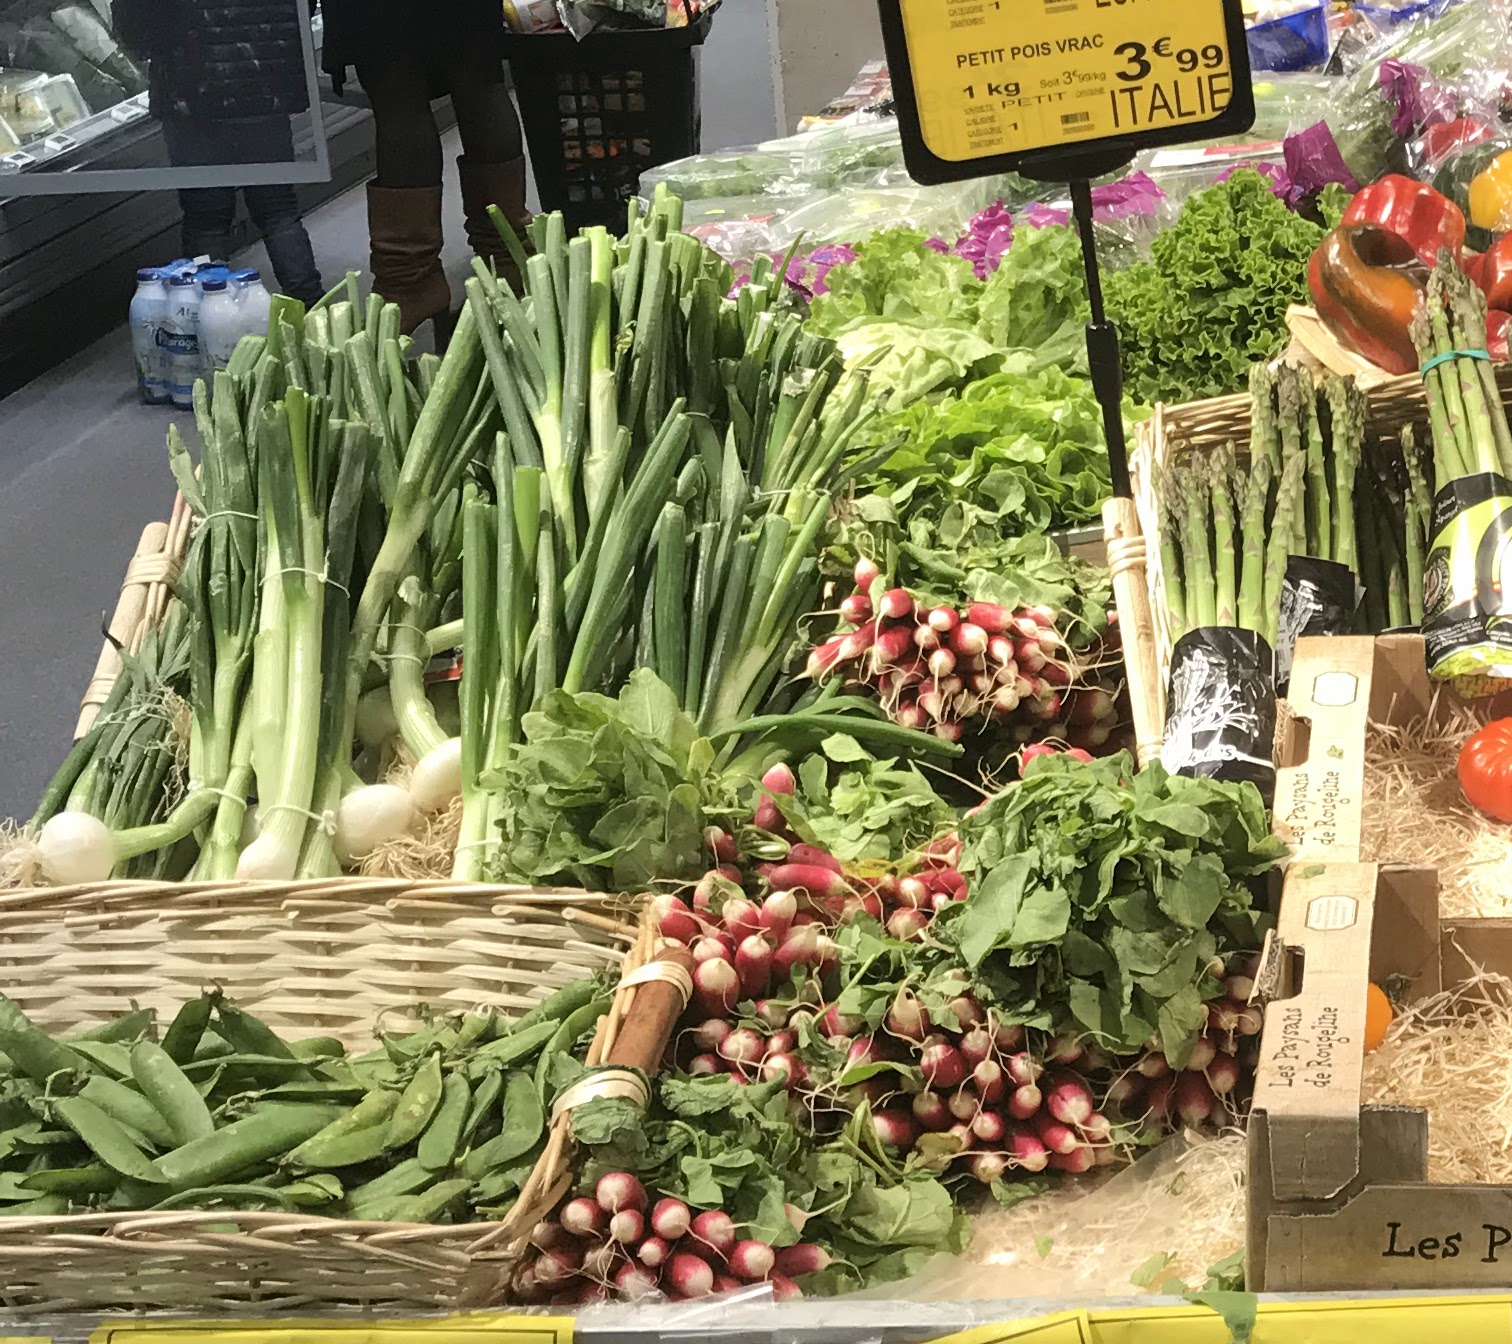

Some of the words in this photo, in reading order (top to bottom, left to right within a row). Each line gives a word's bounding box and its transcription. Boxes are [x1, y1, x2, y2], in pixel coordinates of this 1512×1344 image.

[956, 48, 1005, 69] PETIT
[1011, 42, 1051, 60] POIS
[1055, 34, 1104, 53] VRAC
[963, 85, 975, 99] 1
[987, 81, 1021, 97] kg
[1001, 91, 1065, 109] PETIT
[1110, 71, 1230, 128] ITALIE
[1285, 773, 1316, 822] Paysans
[1314, 771, 1350, 827] Rougeline
[1282, 825, 1305, 845] Les
[1313, 831, 1336, 845] de
[1272, 1008, 1309, 1060] Paysans
[1306, 1007, 1350, 1067] Rougeline
[1268, 1065, 1295, 1087] Les
[1304, 1072, 1331, 1087] de
[1382, 1222, 1462, 1260] Les
